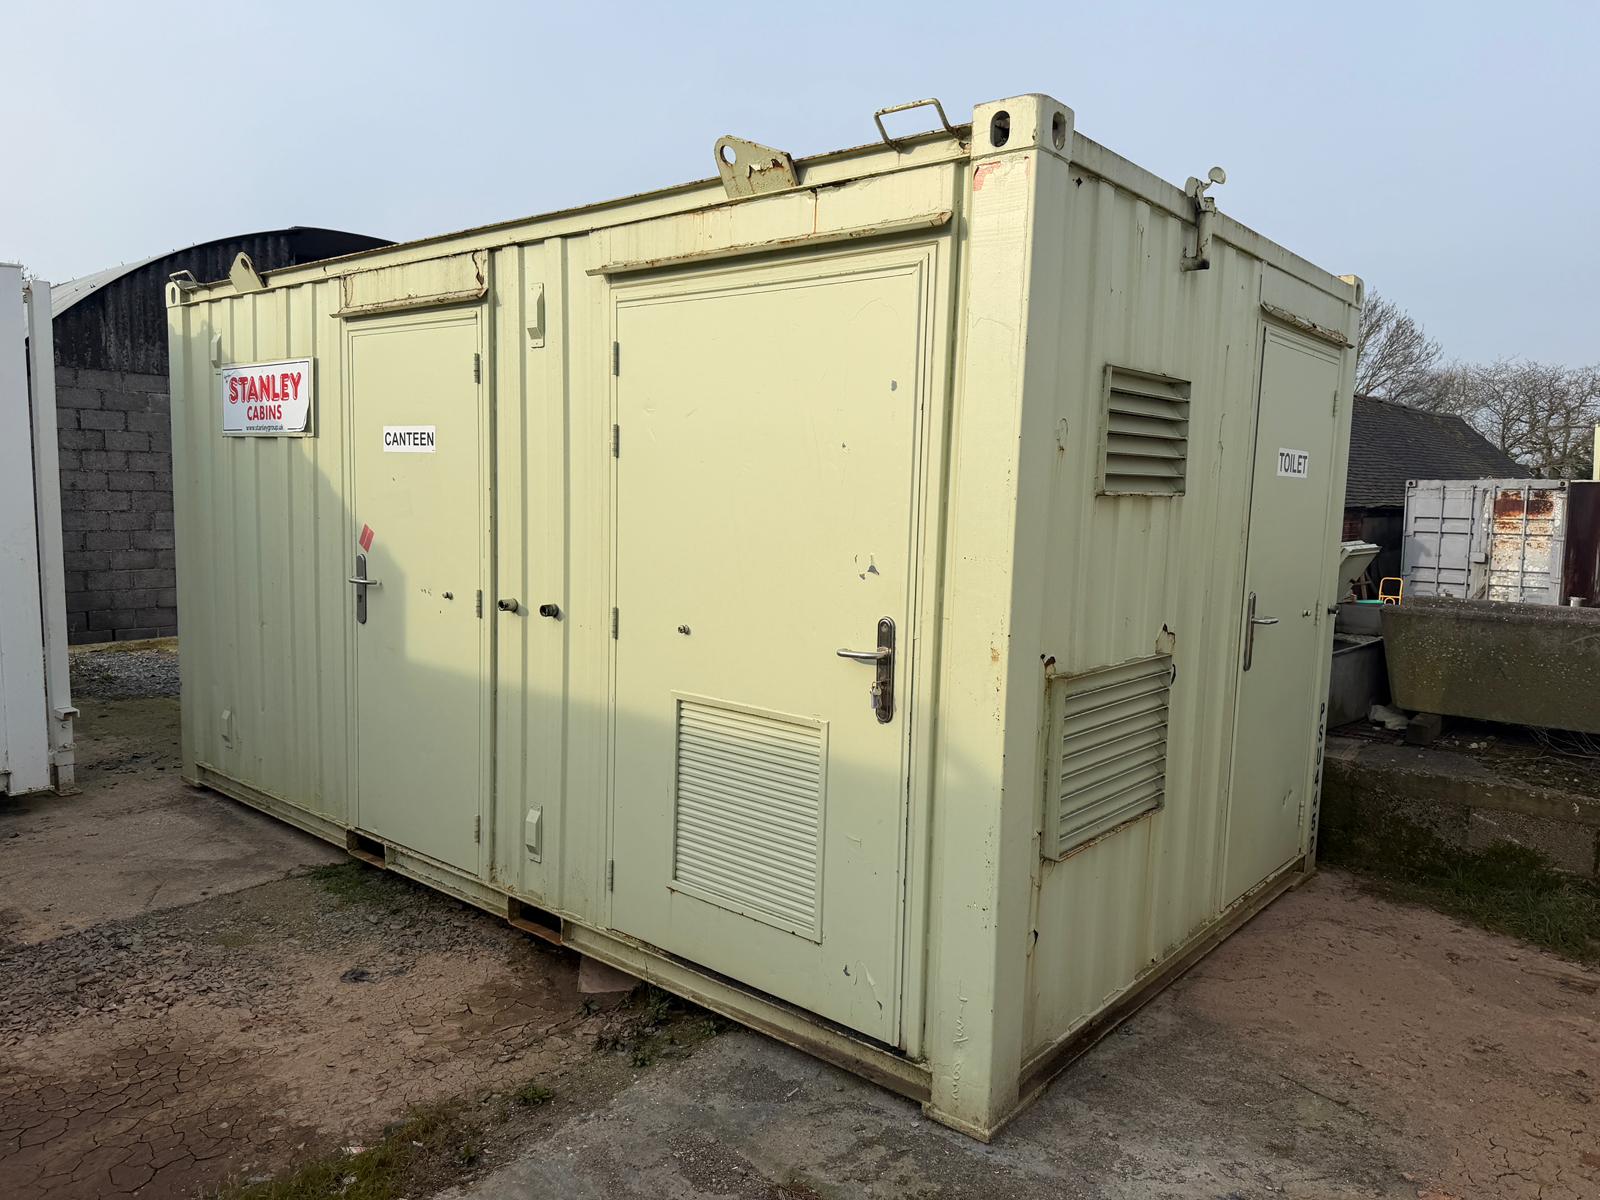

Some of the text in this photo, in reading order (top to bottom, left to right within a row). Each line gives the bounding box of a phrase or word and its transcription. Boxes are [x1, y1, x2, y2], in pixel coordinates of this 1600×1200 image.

[229, 371, 302, 405] STANLEY
[246, 404, 283, 421] CABINS
[384, 431, 434, 446] CANTEEN
[1279, 452, 1308, 474] TOILET
